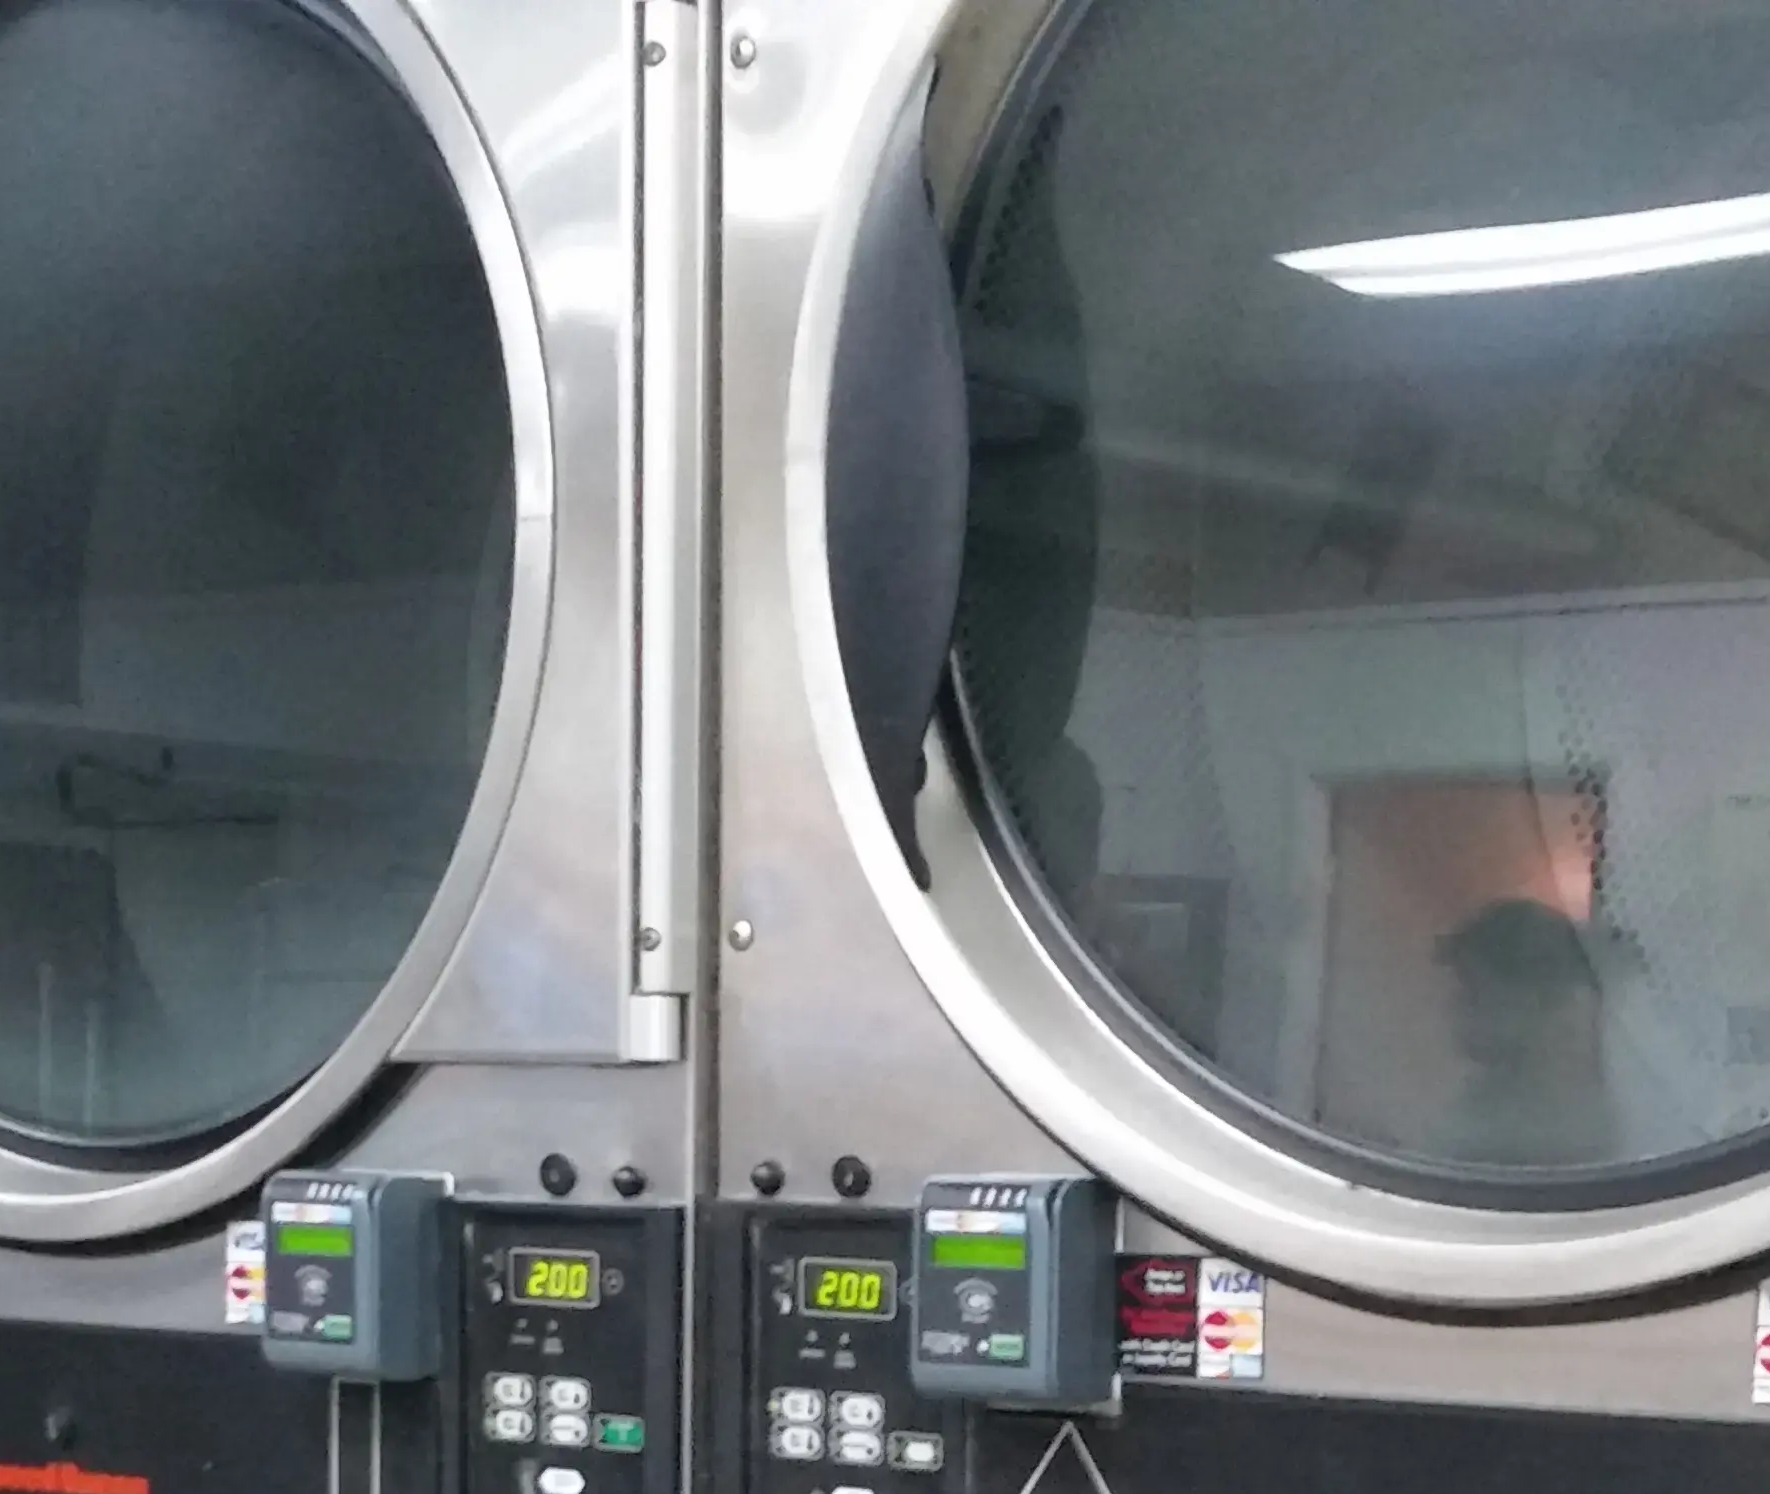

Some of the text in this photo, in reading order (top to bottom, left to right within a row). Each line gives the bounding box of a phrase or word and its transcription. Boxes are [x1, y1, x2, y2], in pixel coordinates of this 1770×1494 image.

[527, 1262, 589, 1299] 200
[815, 1270, 882, 1310] 200
[1208, 1271, 1262, 1294] VISA
